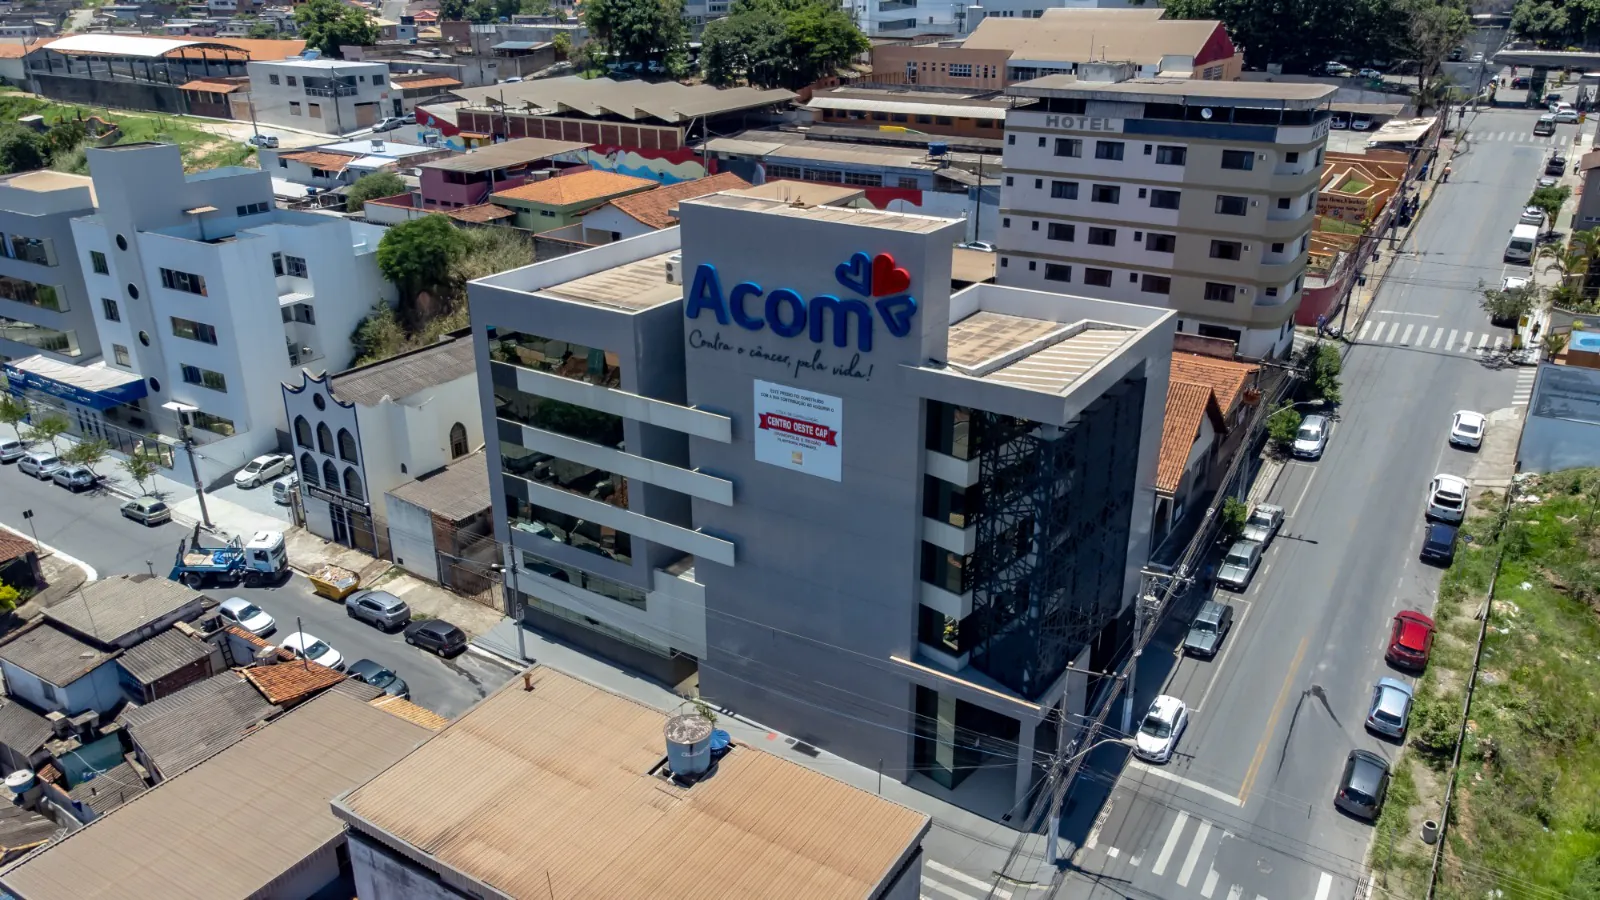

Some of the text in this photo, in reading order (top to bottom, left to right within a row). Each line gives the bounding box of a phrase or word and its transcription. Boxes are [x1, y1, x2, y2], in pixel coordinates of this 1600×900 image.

[1046, 115, 1115, 131] HOTEL
[686, 263, 873, 353] Acom
[689, 329, 734, 351] Contra
[794, 349, 827, 379] pela
[832, 353, 874, 382] vida!
[767, 415, 791, 429] CENTRO
[793, 422, 814, 436] OESTE
[815, 427, 828, 438] CAP
